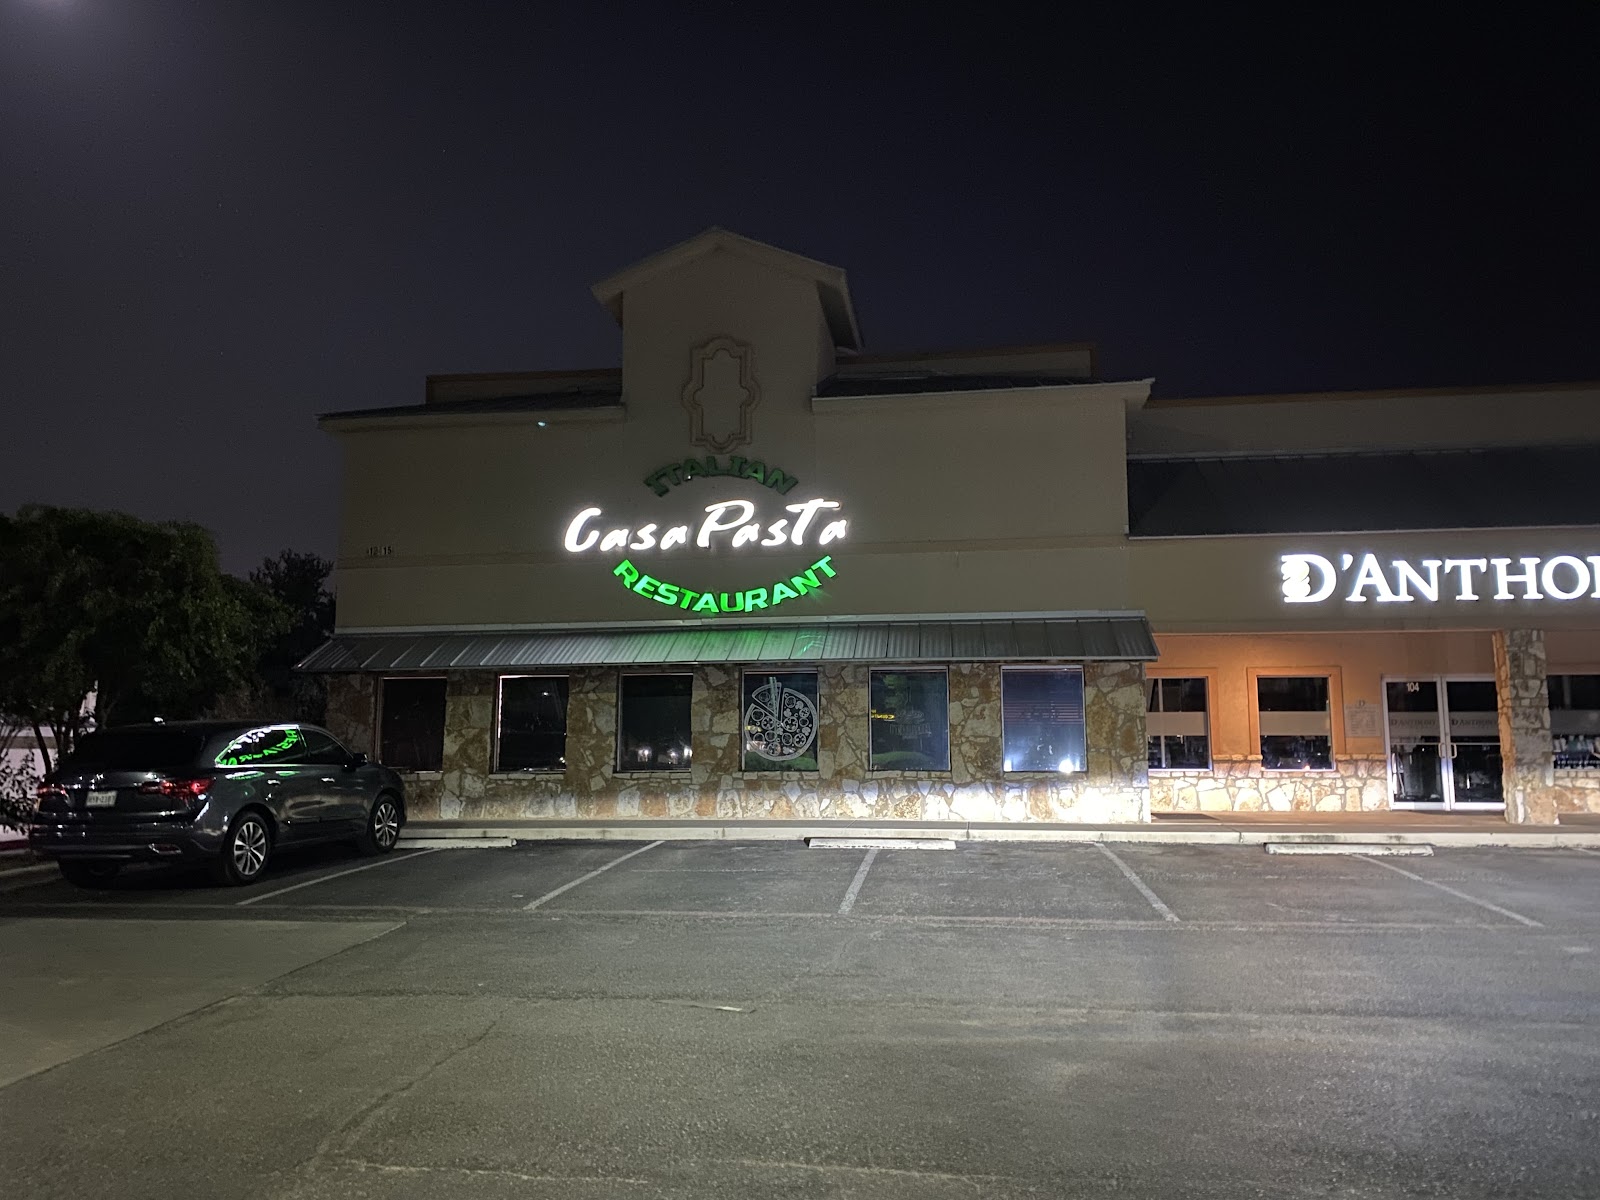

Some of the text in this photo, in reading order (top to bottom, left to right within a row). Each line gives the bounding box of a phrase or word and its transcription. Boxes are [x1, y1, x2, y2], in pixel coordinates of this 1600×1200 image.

[643, 455, 798, 497] ITALIAN
[564, 506, 689, 553] Casa
[612, 555, 838, 615] RESTAURANT
[1406, 682, 1420, 693] 104
